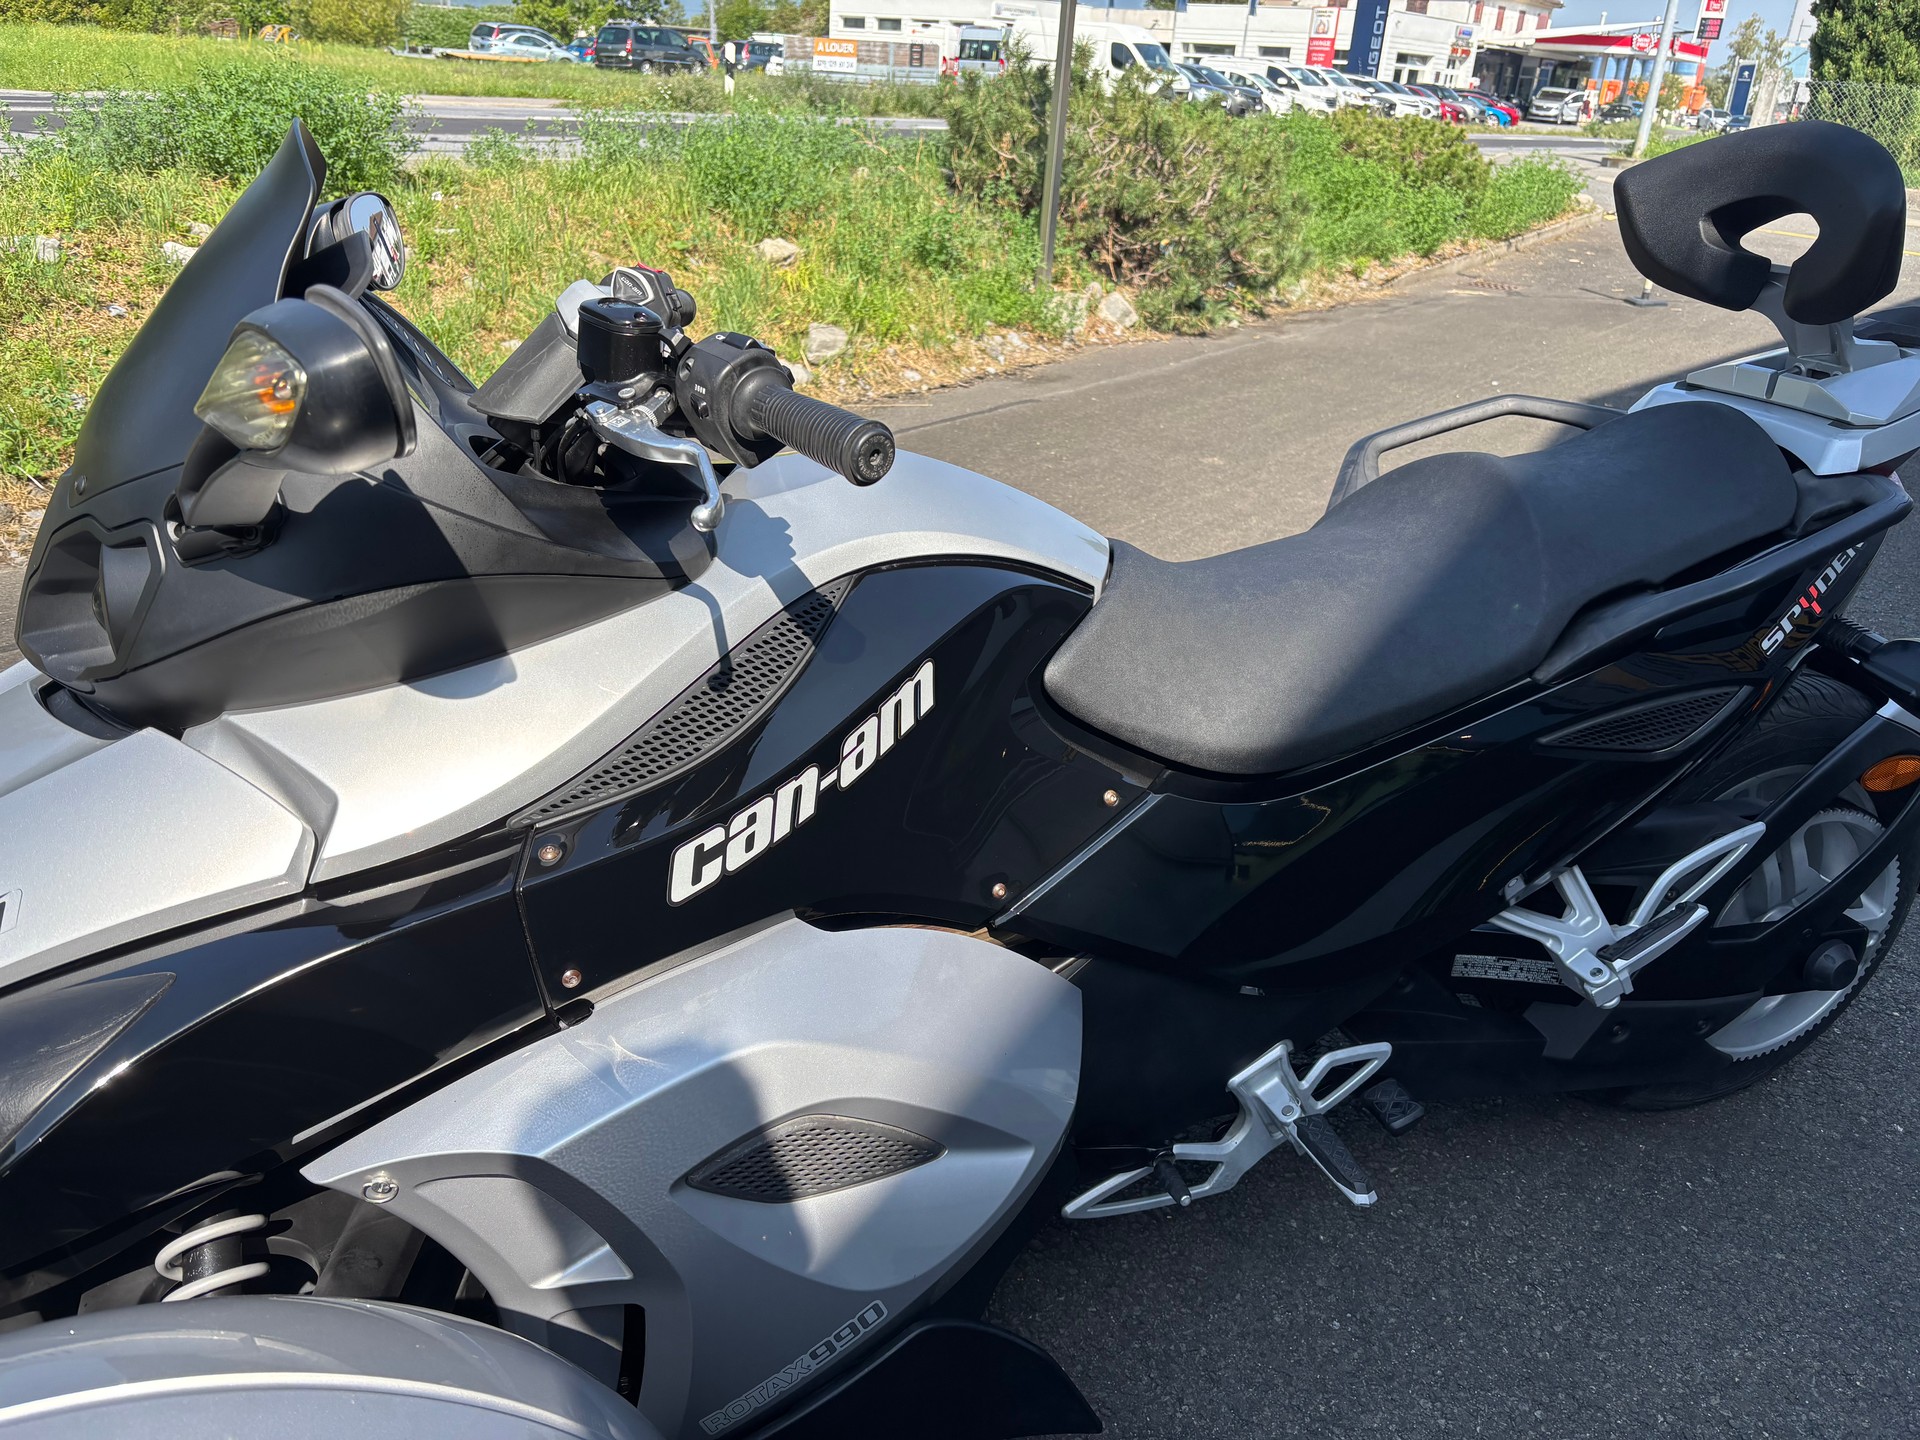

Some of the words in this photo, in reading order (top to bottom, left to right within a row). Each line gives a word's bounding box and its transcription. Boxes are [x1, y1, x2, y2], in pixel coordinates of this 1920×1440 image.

[825, 42, 854, 53] LOUER
[1367, 5, 1386, 77] UGEOT
[702, 1357, 811, 1434] ROTAX
[808, 1302, 886, 1366] 990
